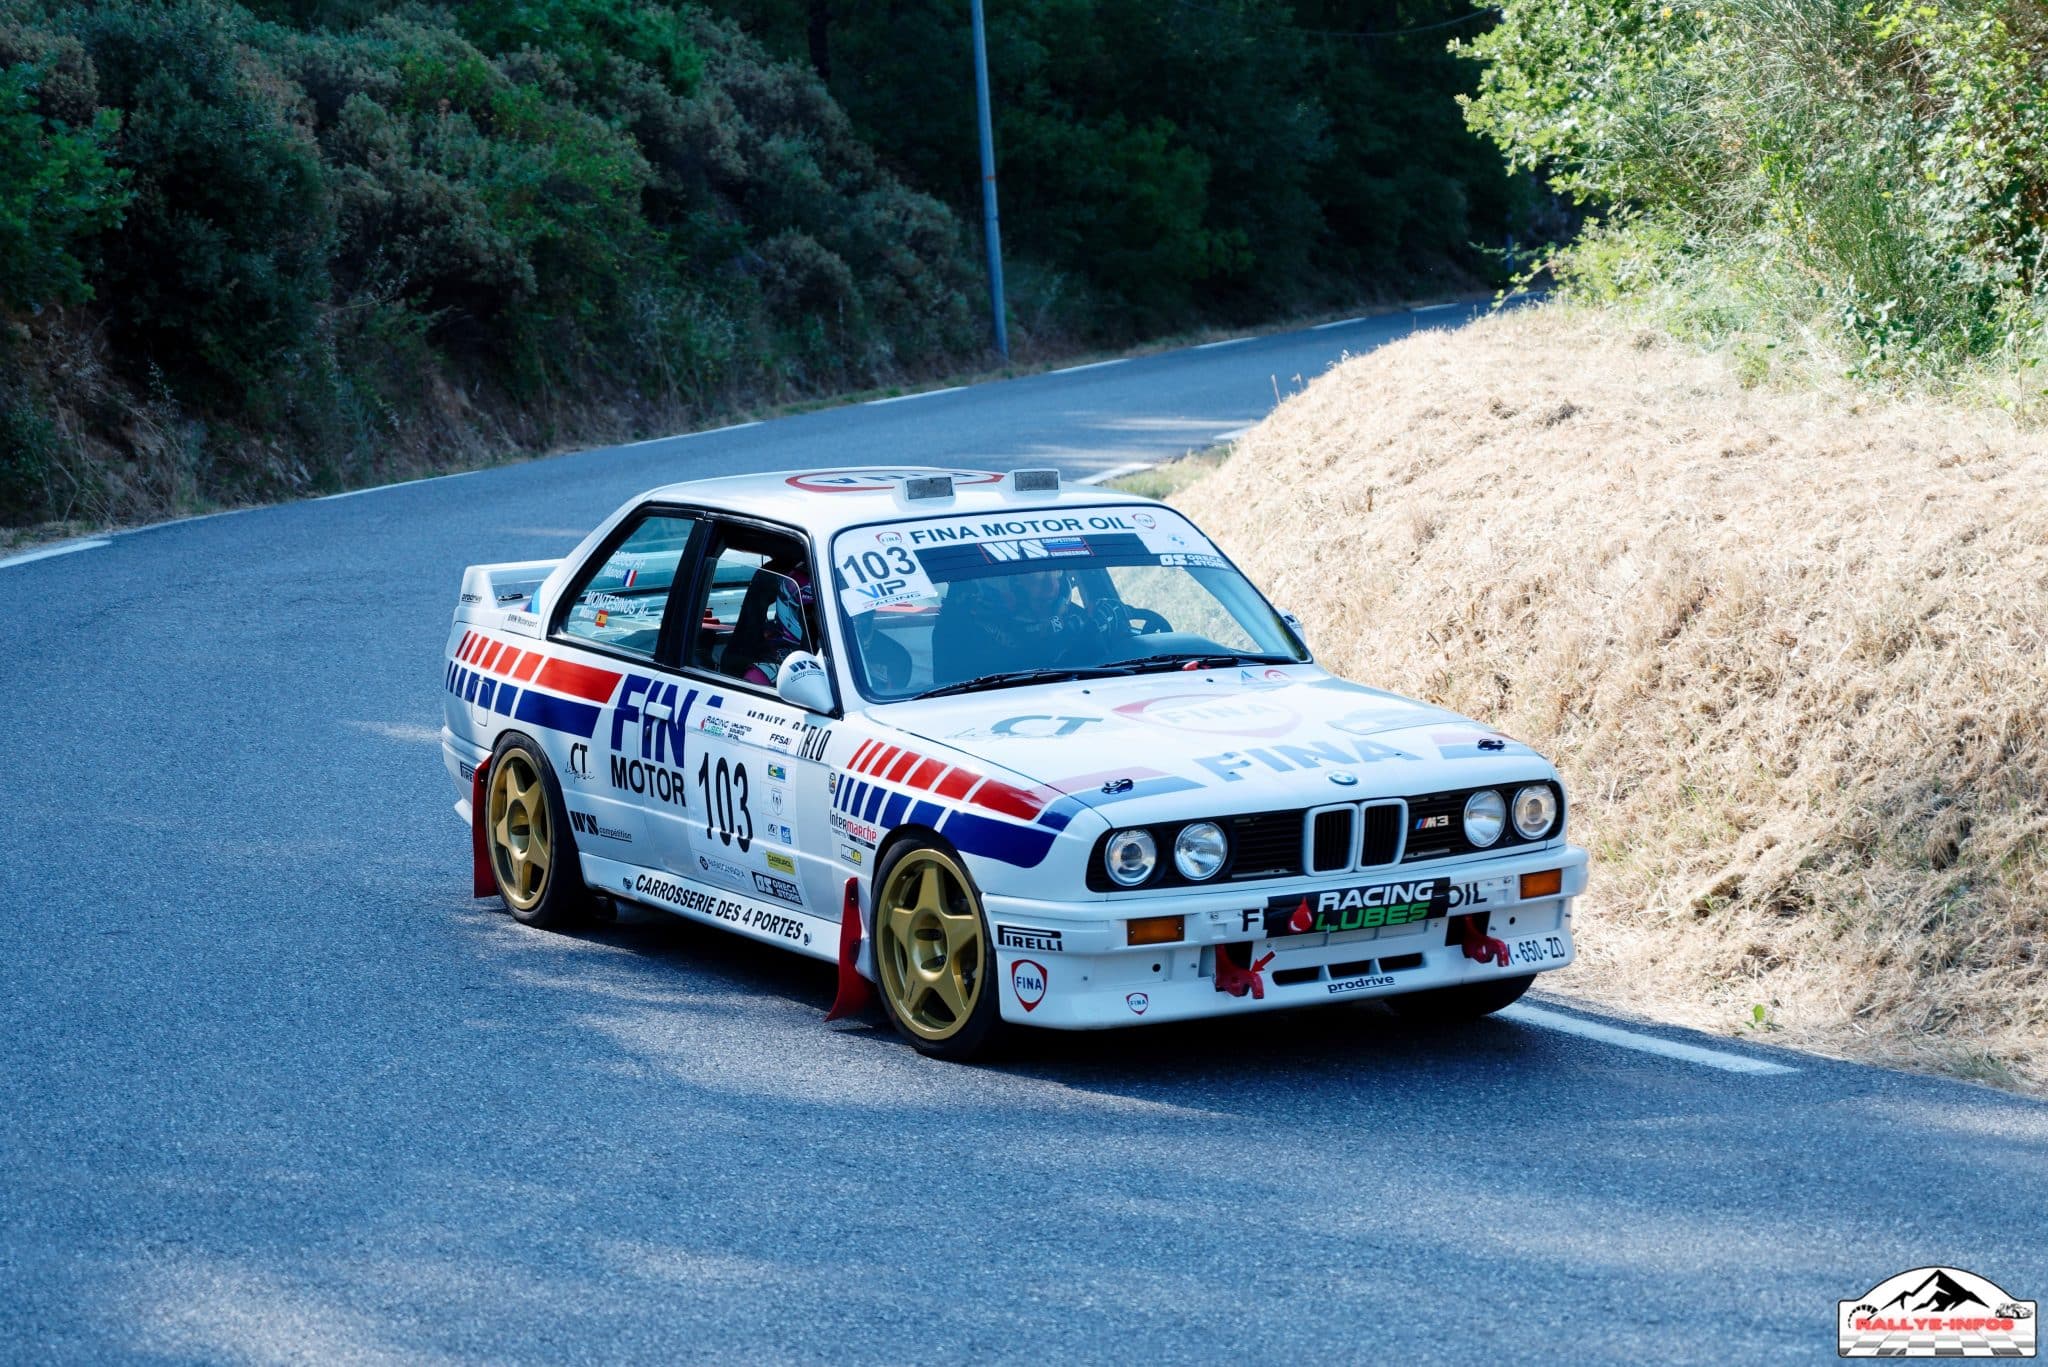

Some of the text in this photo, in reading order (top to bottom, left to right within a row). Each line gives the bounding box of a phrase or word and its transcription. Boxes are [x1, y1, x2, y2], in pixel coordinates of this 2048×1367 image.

[909, 516, 1136, 544] FINA MOTOR OIL
[843, 546, 916, 583] 103
[856, 579, 906, 599] VIP
[584, 591, 638, 615] MONTESINOS
[990, 714, 1104, 736] CT
[769, 733, 789, 746] FFSA
[570, 742, 588, 774] CT
[1193, 740, 1424, 782] FINA
[610, 754, 687, 808] MOTOR
[698, 751, 754, 853] 103
[569, 811, 599, 836] WS
[1422, 815, 1449, 829] M3
[635, 873, 804, 940] CARROSSERIE DES 4 PORTES
[1317, 881, 1435, 912] RACING
[1315, 902, 1431, 931] LUBES
[997, 925, 1063, 951] PIRELLI
[1016, 976, 1043, 991] FINA
[1327, 974, 1395, 994] prodrive
[1129, 998, 1147, 1006] FINA
